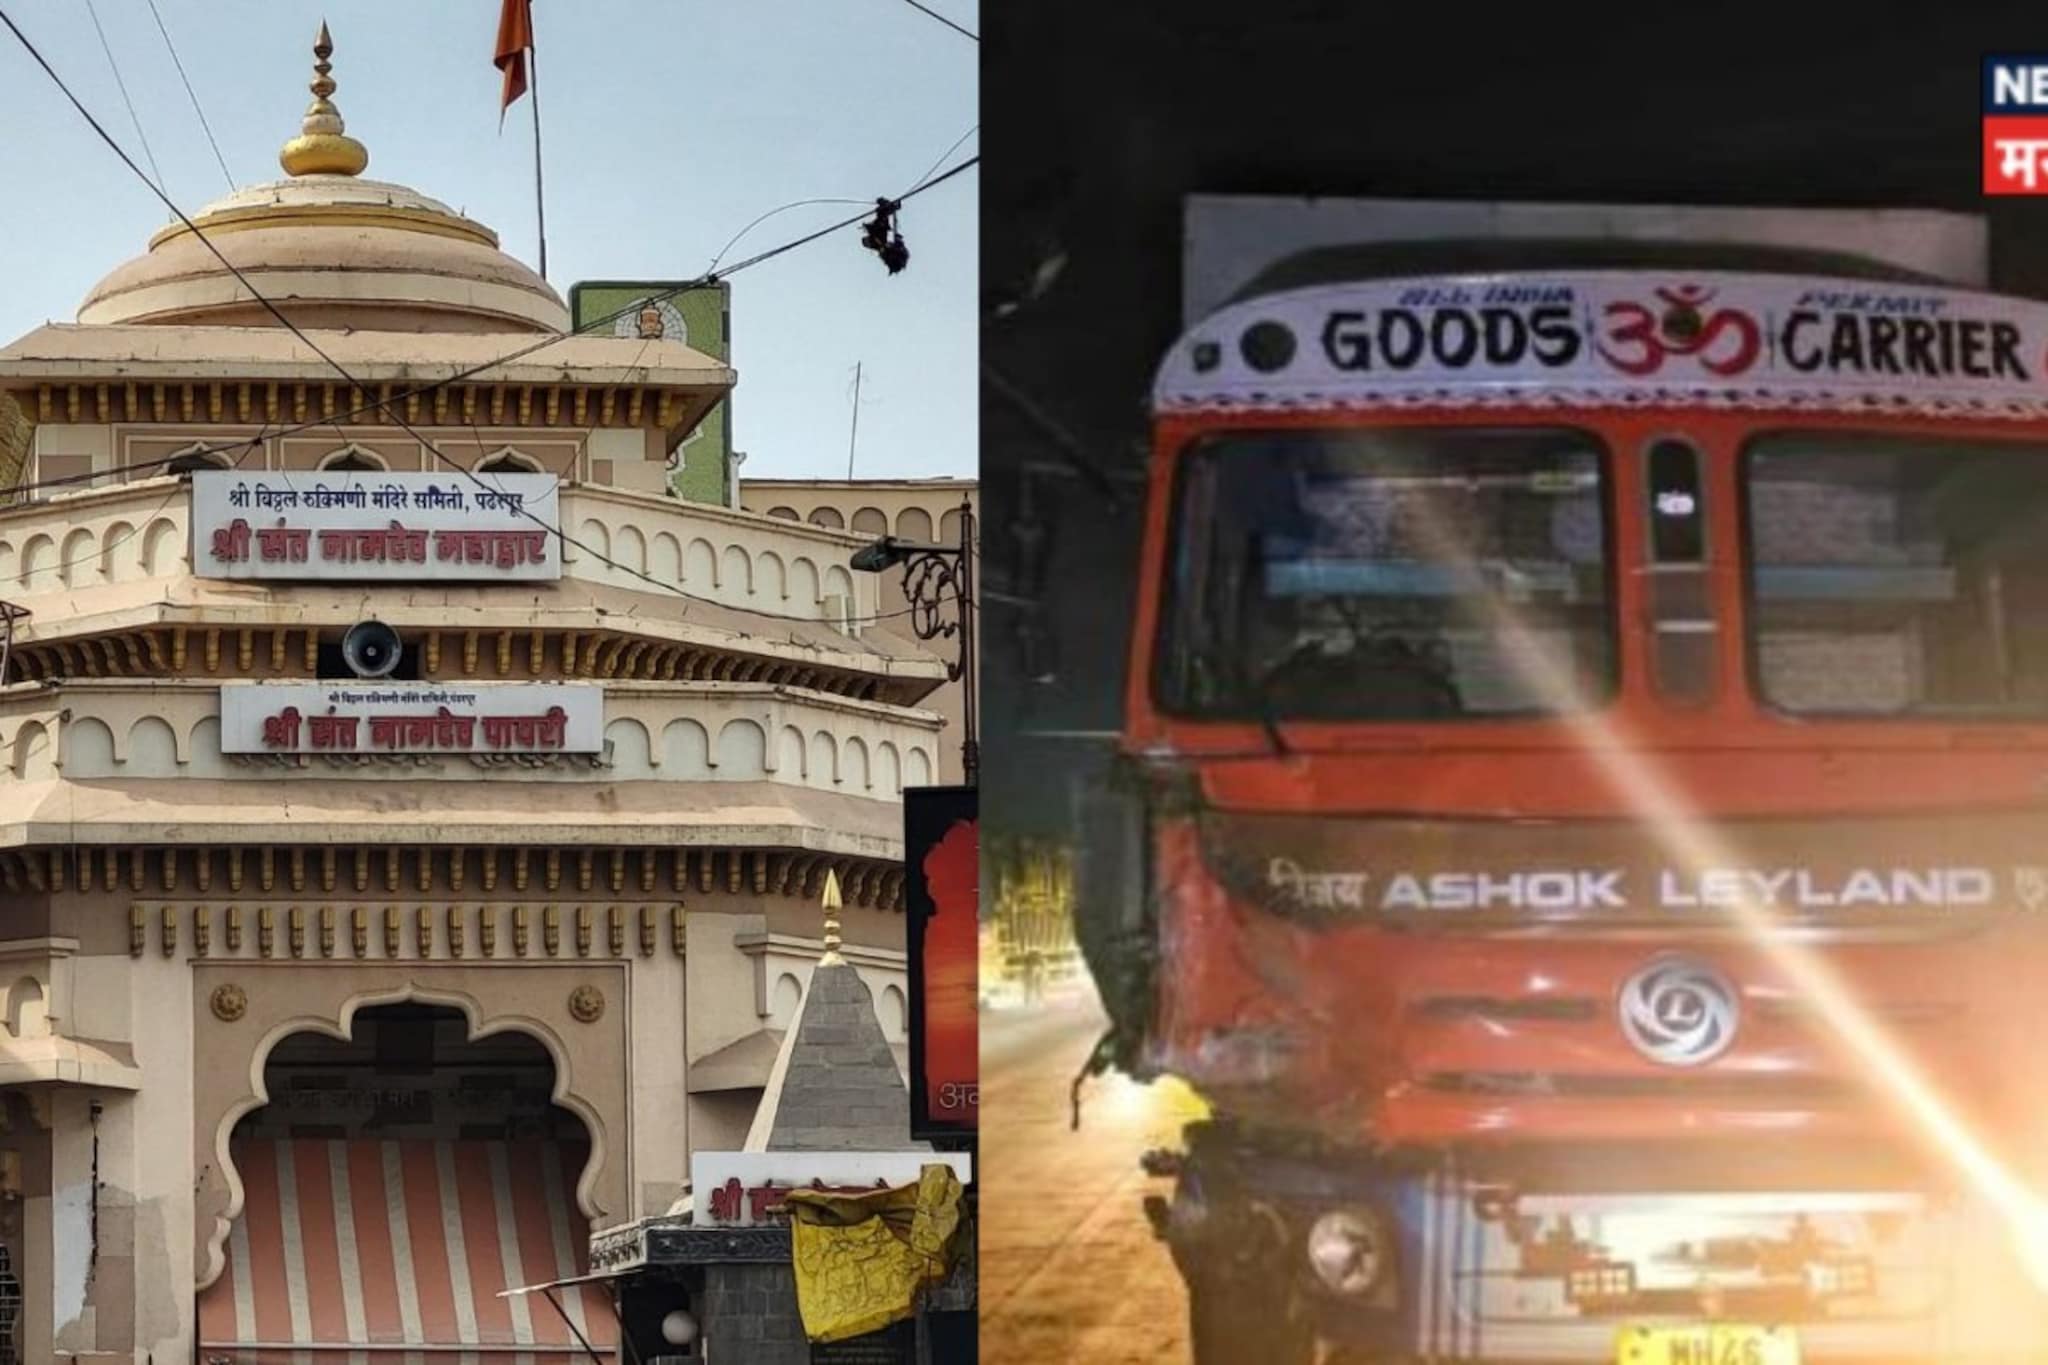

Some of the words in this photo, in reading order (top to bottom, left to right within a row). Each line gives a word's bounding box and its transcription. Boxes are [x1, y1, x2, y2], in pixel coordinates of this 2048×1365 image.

[1322, 308, 1581, 371] GOODS
[1782, 312, 2030, 382] CARRIER
[229, 482, 250, 507] श्री
[210, 518, 251, 562] श्री
[256, 516, 312, 562] संत
[317, 519, 429, 564] नामदेव
[262, 706, 302, 748] श्री
[308, 705, 360, 748] संत
[368, 706, 477, 749] नामदेव
[481, 706, 568, 748] पायरी
[1381, 868, 1627, 909] ASHOK
[1660, 868, 1993, 906] LEYLAND
[708, 1177, 743, 1221] श्री
